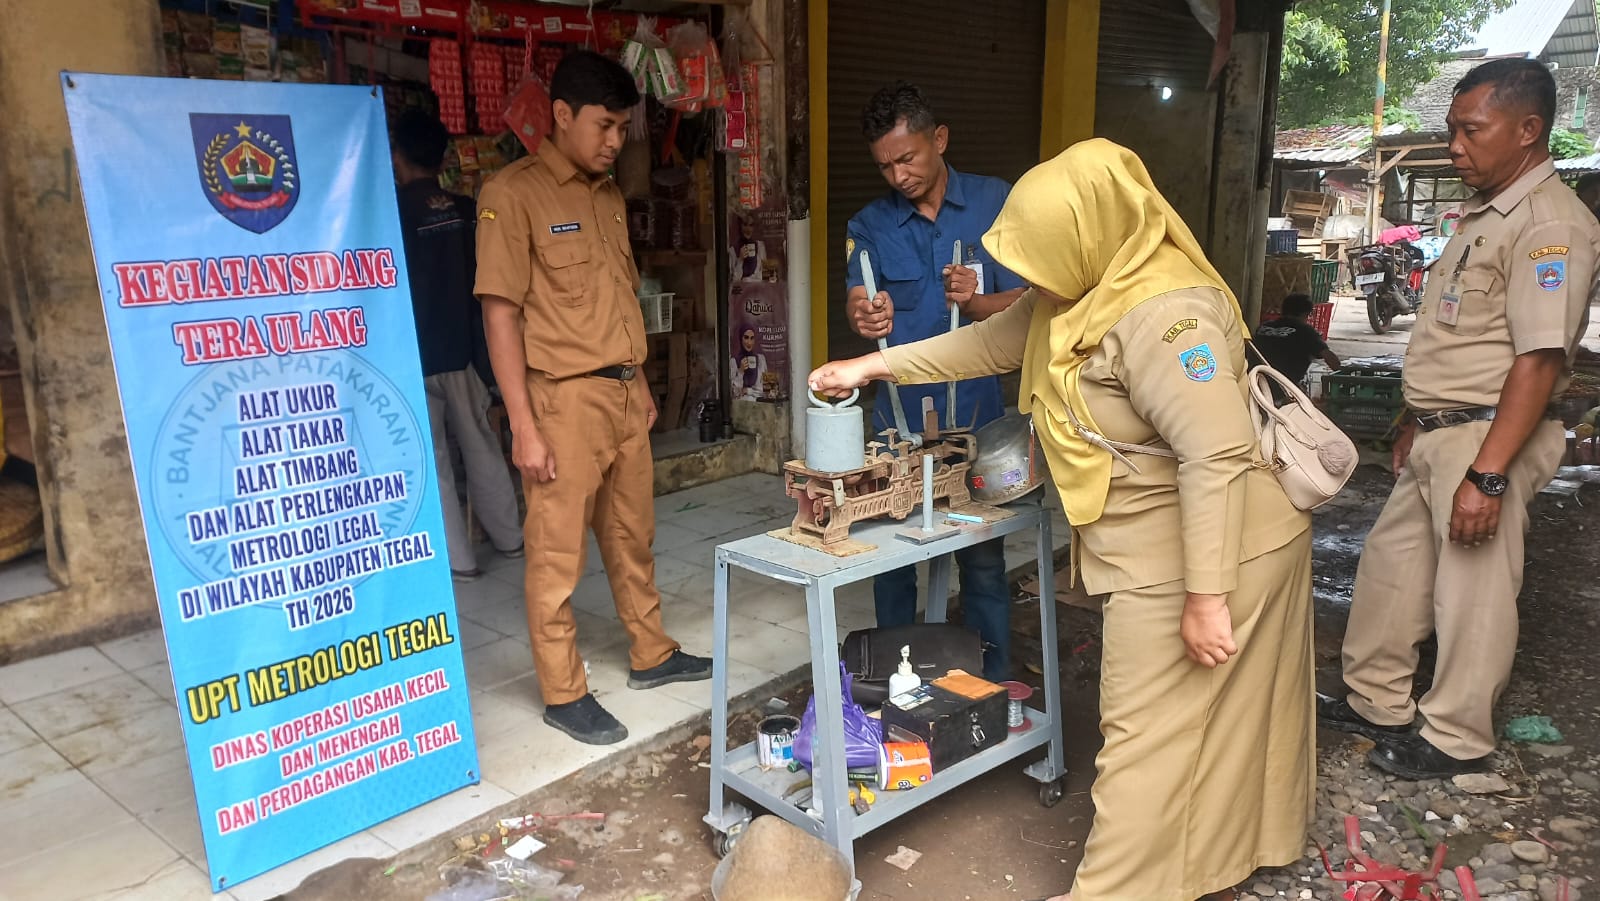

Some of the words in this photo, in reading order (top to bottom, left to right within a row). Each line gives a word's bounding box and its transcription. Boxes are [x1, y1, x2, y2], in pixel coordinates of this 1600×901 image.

[114, 254, 290, 306] KEGIATAN
[289, 249, 396, 294] SIDANG
[173, 316, 268, 364] TERA
[263, 308, 366, 355] ULANG
[168, 358, 271, 484] BANTJANA
[278, 355, 411, 446] PATAKARAN
[240, 390, 279, 421] ALAT
[286, 384, 336, 414] UKUR
[241, 427, 283, 458] ALAT
[287, 418, 344, 450] TAKAR
[236, 464, 277, 495] ALAT
[281, 450, 357, 486] TIMBANG
[189, 509, 229, 541] DAN
[234, 502, 276, 533] ALAT
[281, 475, 405, 523] PERLENGKAPAN
[230, 527, 331, 569] METROLOGI
[334, 513, 381, 544] LEGAL
[180, 591, 201, 620] DI
[205, 569, 286, 613] WILAYAH
[290, 545, 382, 592] KABUPATEN
[384, 534, 432, 566] TEGAL
[286, 599, 311, 629] TH
[313, 586, 353, 622] 2026
[187, 674, 241, 724] UPT
[247, 632, 382, 707] METROLOGI
[384, 612, 453, 661] TEGAL
[212, 732, 268, 769] DINAS
[272, 703, 349, 750] KOPERASI
[352, 684, 404, 719] USAHA
[406, 670, 448, 700] KECIL
[281, 747, 314, 777] DAN
[319, 716, 400, 762] MENENGAH
[217, 804, 256, 834] DAN
[260, 755, 376, 818] PERDAGANGAN
[379, 741, 414, 770] KAB.
[416, 723, 461, 754] TEGAL
